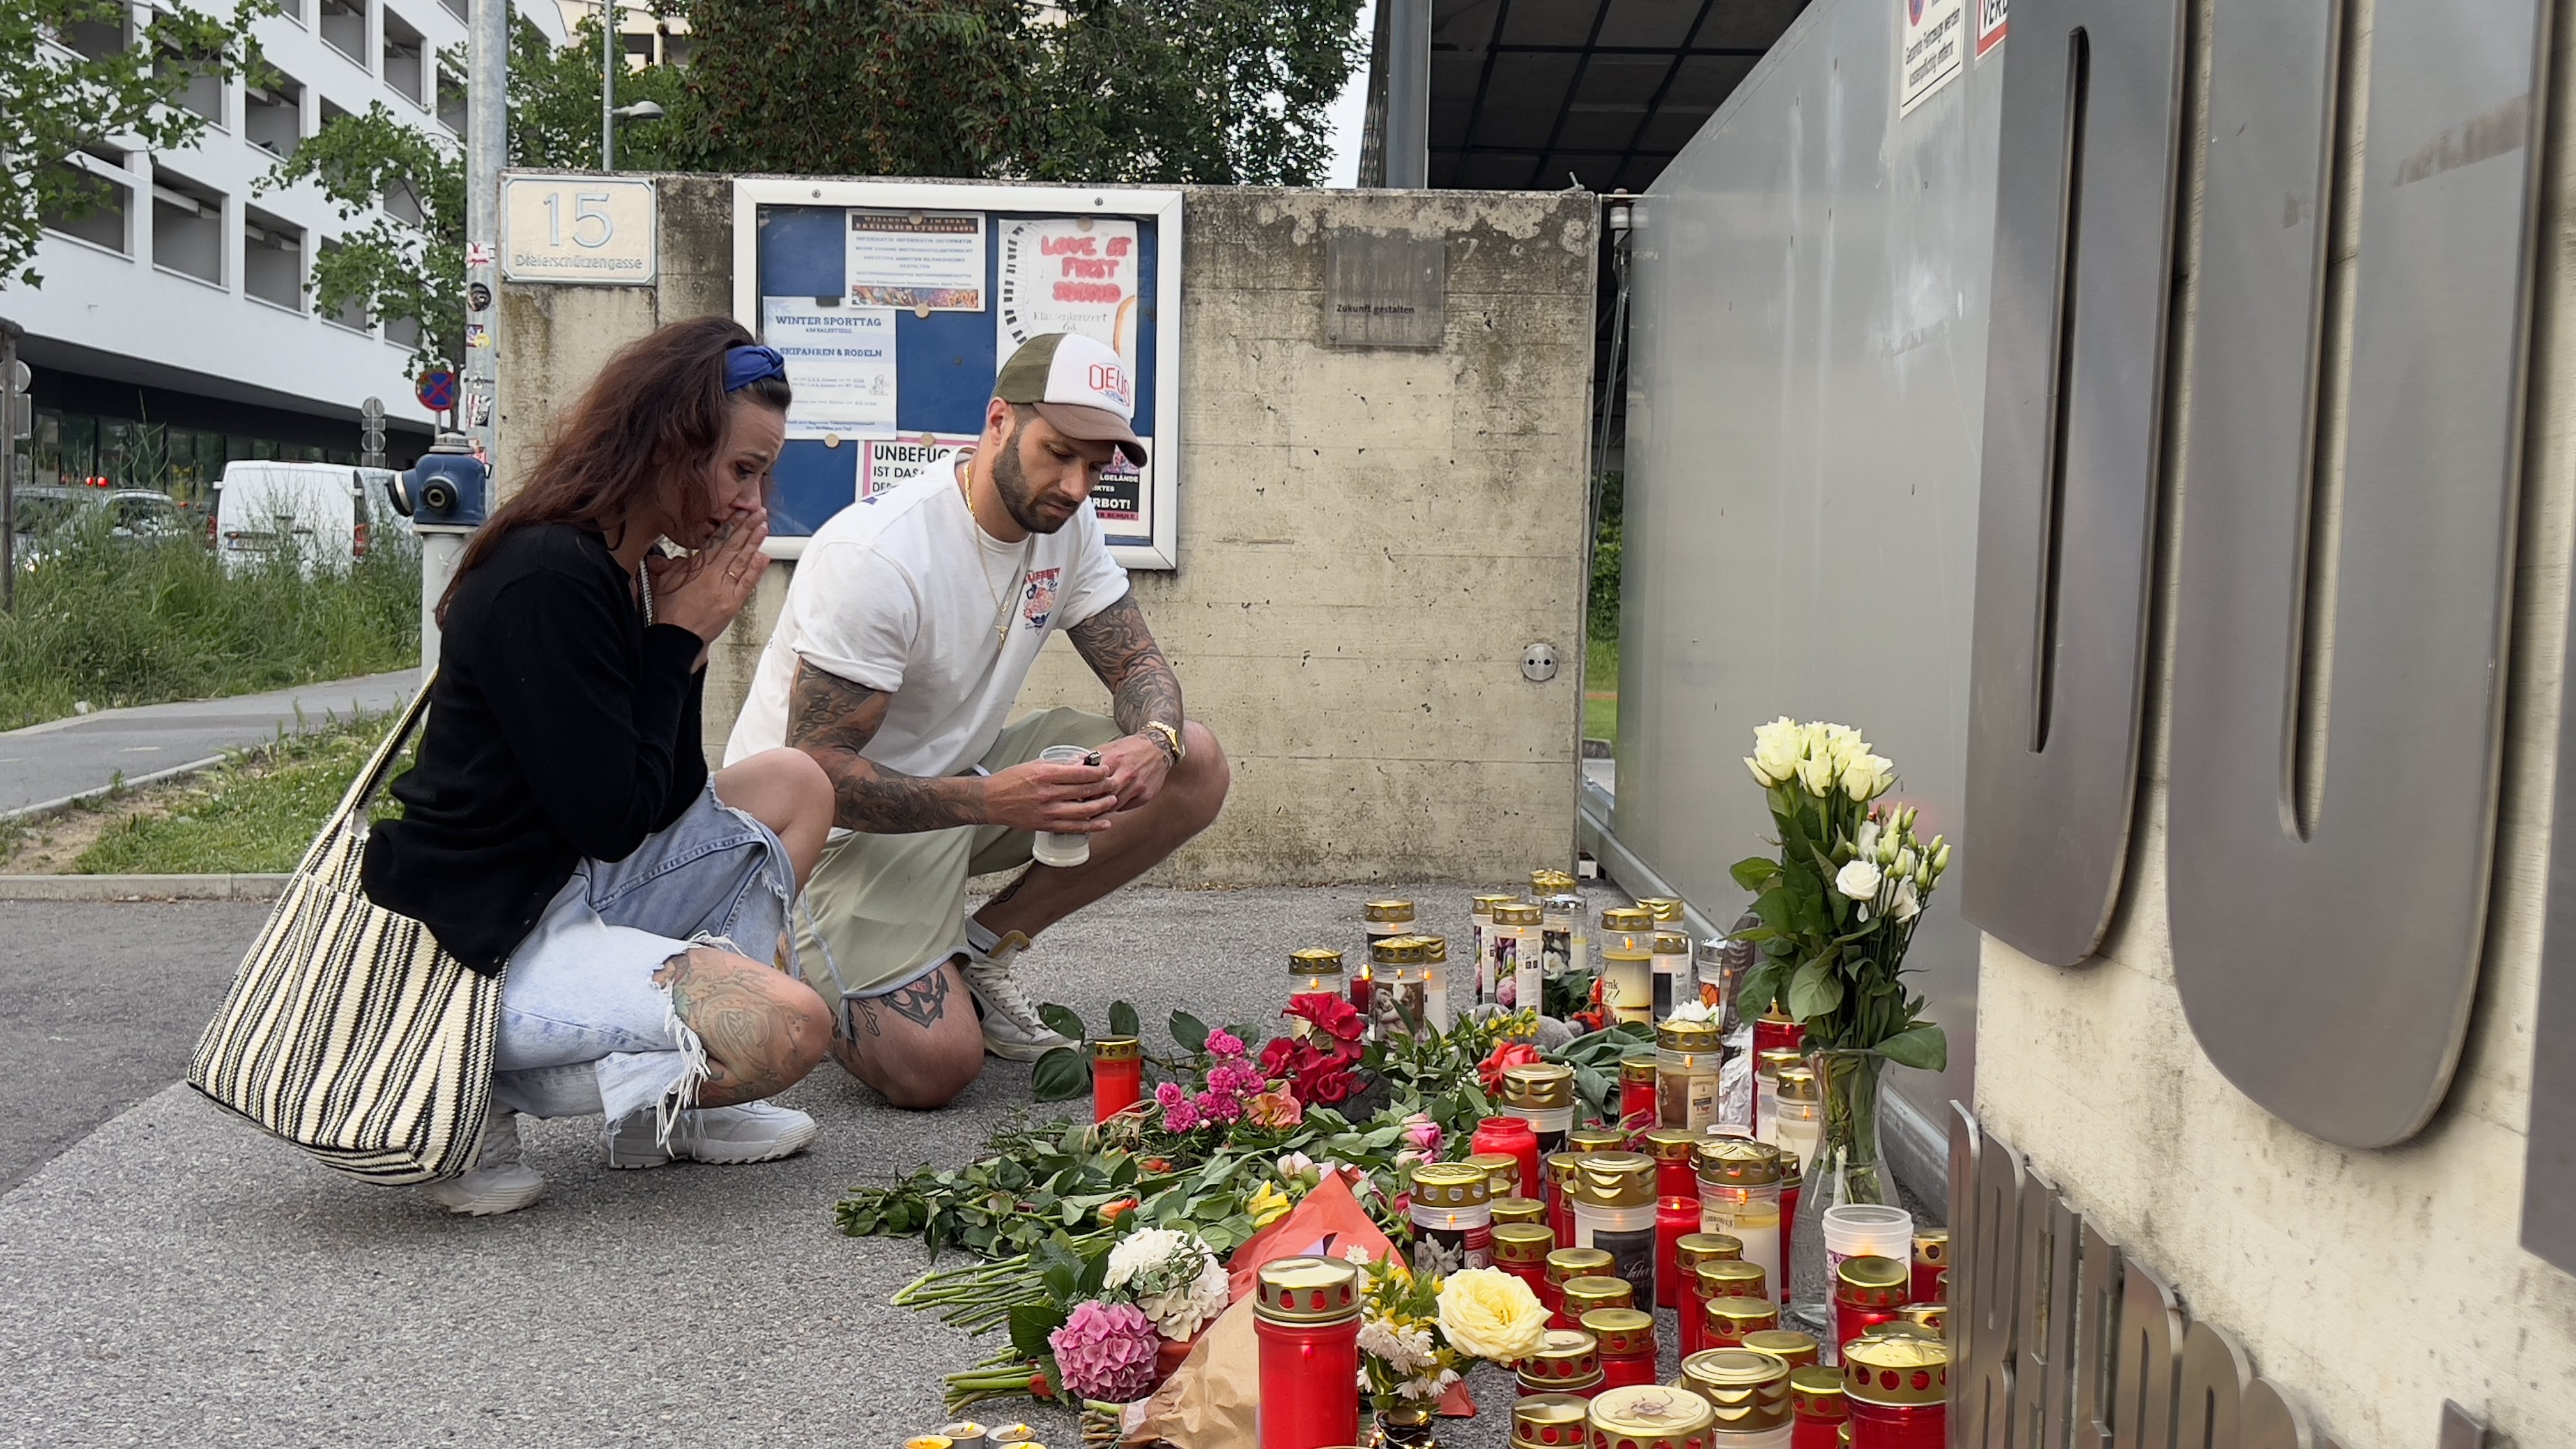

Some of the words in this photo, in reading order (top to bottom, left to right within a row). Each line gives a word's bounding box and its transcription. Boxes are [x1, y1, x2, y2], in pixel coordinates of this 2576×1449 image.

[544, 192, 613, 248] 15
[1041, 235, 1097, 256] LOVE
[1106, 236, 1132, 256] AT
[1062, 257, 1119, 279] FIRST
[1337, 304, 1371, 313] Zukunft
[1374, 305, 1414, 315] gestalten
[776, 316, 821, 325] WINTER
[824, 317, 882, 326] SPORTTAG
[779, 348, 834, 356] SKIFAHREN
[845, 349, 882, 357] RODELN
[875, 445, 950, 463] UNBEFUG
[874, 466, 889, 477] IST
[894, 467, 918, 478] DAS
[1092, 498, 1131, 510] RBOT!
